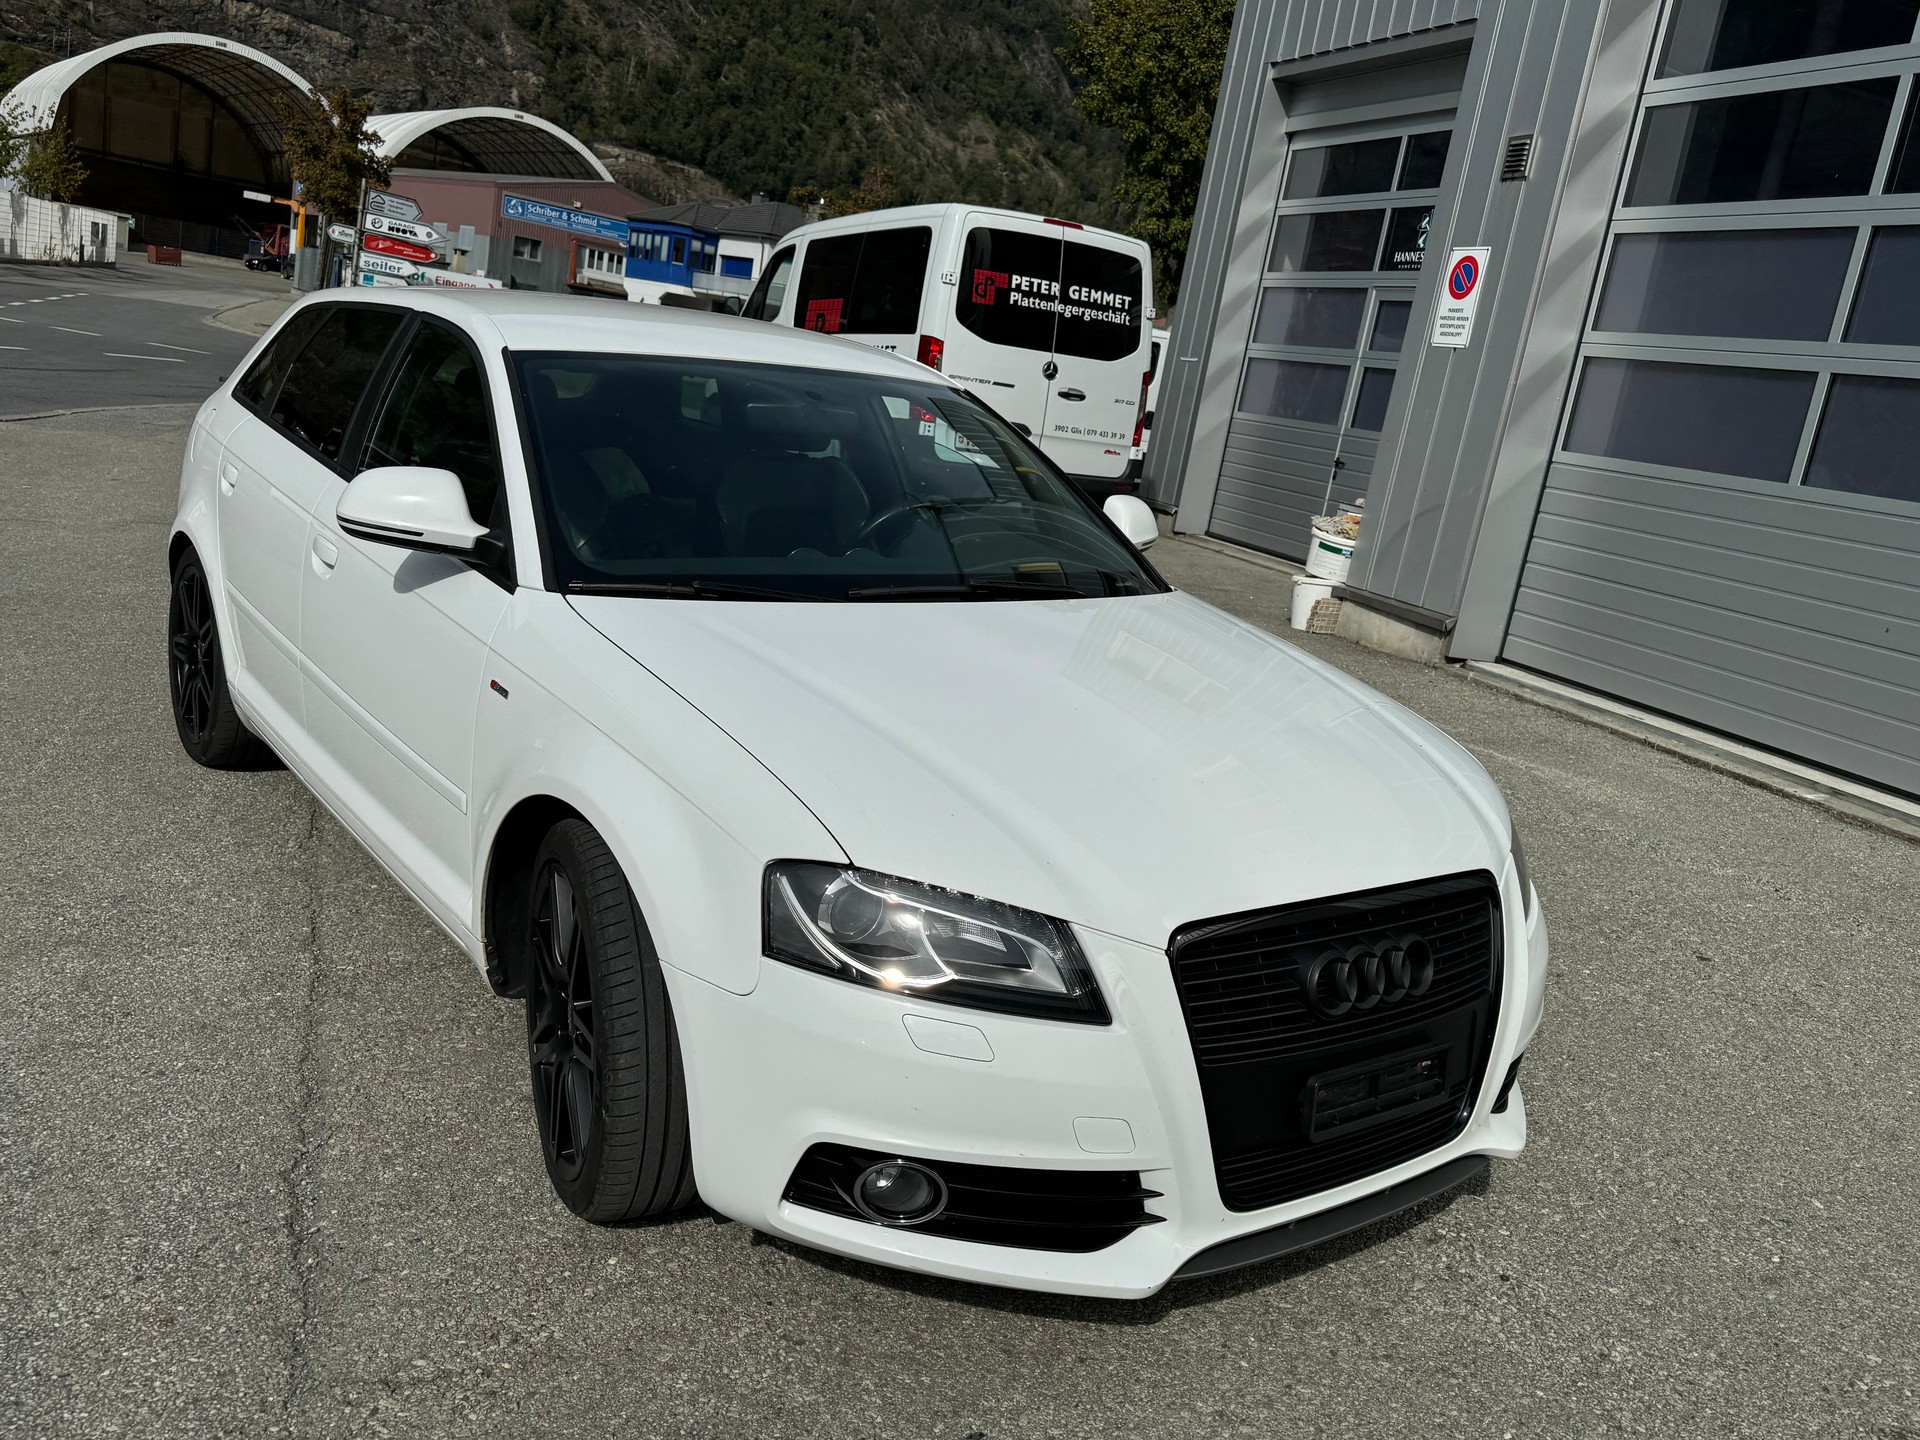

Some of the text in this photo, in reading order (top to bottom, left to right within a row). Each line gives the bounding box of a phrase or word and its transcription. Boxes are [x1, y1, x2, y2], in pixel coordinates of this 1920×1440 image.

[527, 204, 560, 218] Schriber
[561, 211, 568, 220] &
[570, 213, 598, 226] Schmid
[388, 220, 415, 229] GARAGE
[1393, 251, 1425, 262] HANNES
[363, 259, 403, 273] seiler
[1011, 274, 1132, 310] PETER GEMMET
[1009, 291, 1131, 326] Plattenlegergeschäft
[948, 374, 991, 384] SPRINTER
[1054, 424, 1069, 433] 3902
[1070, 427, 1082, 435] Glis
[1086, 429, 1098, 437] 079
[1098, 430, 1109, 438] 433
